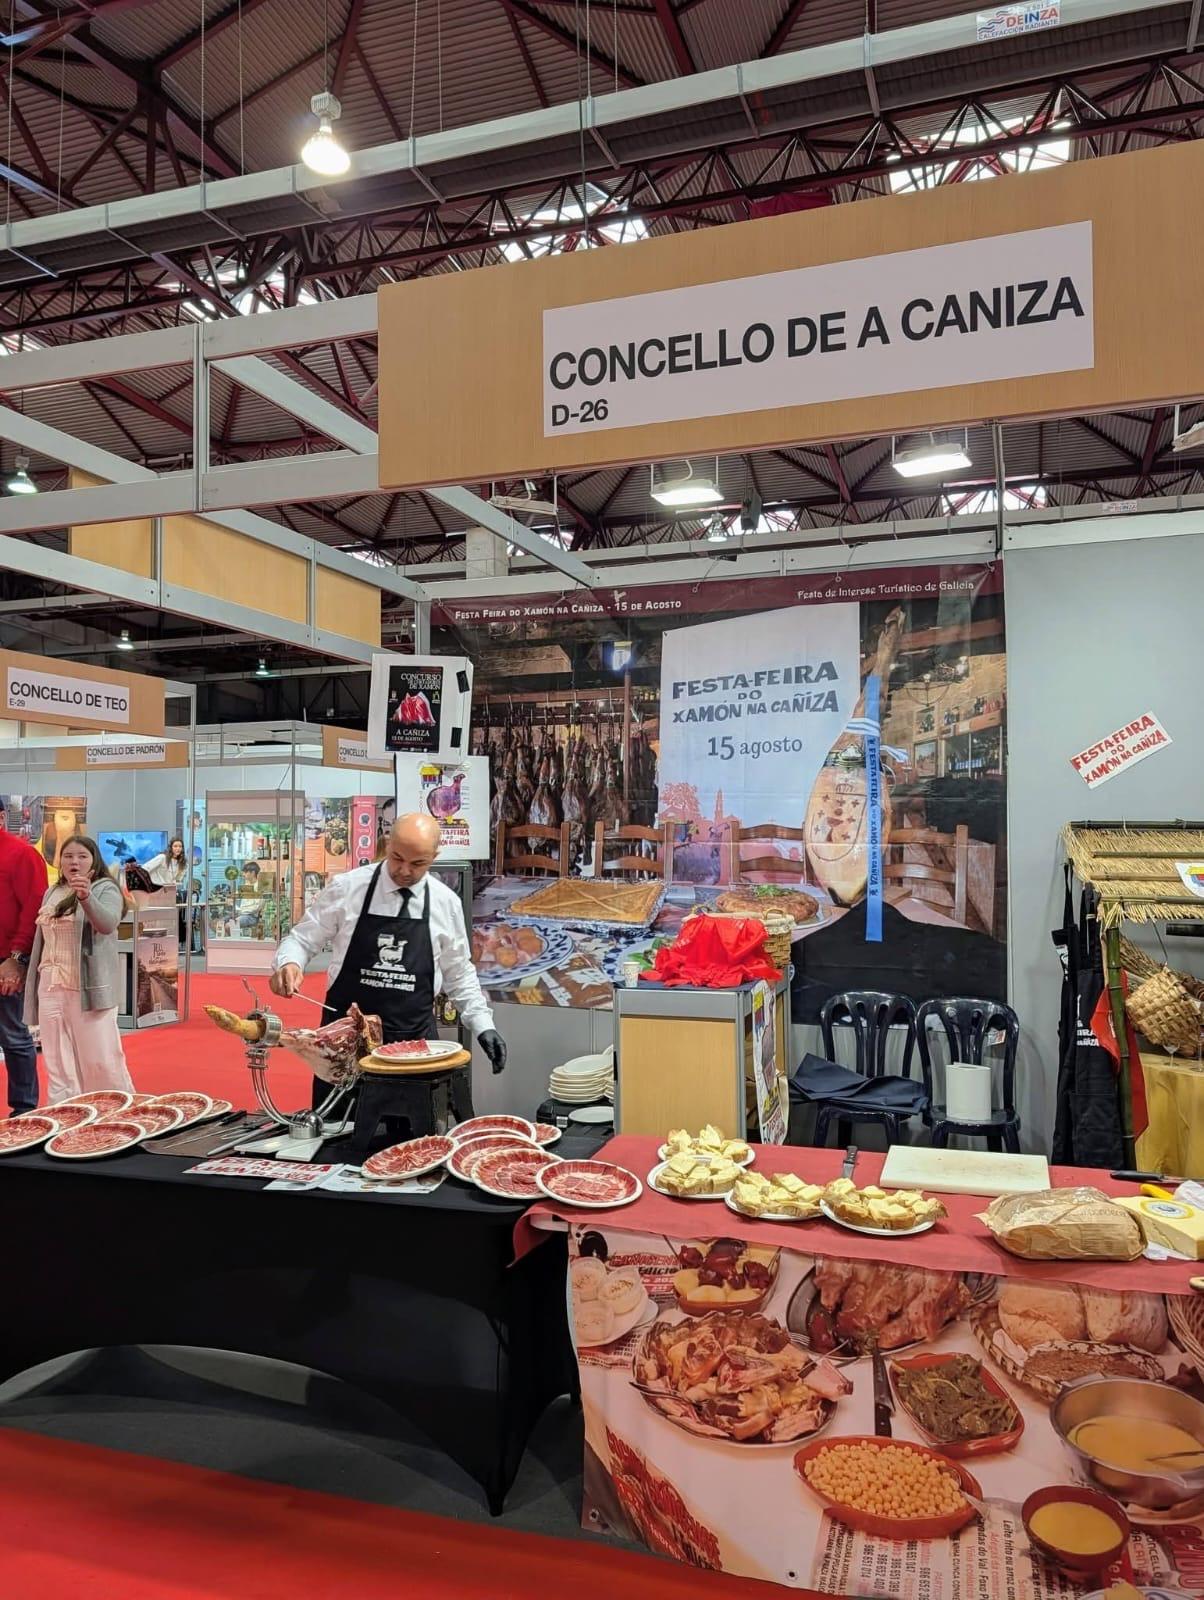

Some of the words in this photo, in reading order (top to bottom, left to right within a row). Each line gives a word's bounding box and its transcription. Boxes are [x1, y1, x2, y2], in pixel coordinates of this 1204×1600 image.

[1006, 7, 1058, 28] DEINZA
[1024, 19, 1057, 30] RADIANTE
[549, 321, 775, 390] CONCELLO
[787, 310, 847, 358] DE
[857, 306, 890, 348] A
[900, 276, 1085, 341] CANIZA
[551, 398, 609, 427] D-26
[825, 588, 836, 598] de
[878, 584, 922, 594] Turístico
[924, 581, 937, 592] de
[939, 580, 974, 591] Galicia
[614, 601, 628, 611] 15
[400, 672, 441, 681] CONCURSO
[672, 660, 840, 700] FESTA-FEIRA
[10, 681, 83, 705] CONCELLO
[86, 693, 102, 708] DE
[104, 696, 127, 712] TEO
[737, 689, 763, 701] DO
[9, 698, 25, 708] E-29
[672, 700, 742, 723] XAMÓN
[747, 702, 768, 716] NA
[707, 736, 735, 760] 15
[739, 737, 803, 760] agosto
[1071, 715, 1155, 770] FESTA-FEIRA
[1110, 744, 1125, 755] DO
[88, 746, 123, 757] CONCELLO
[125, 746, 135, 755] DE
[135, 744, 165, 755] PADRÓN
[1120, 750, 1133, 761] NA
[1003, 1520, 1014, 1539] Leite
[978, 1547, 988, 1557] do
[979, 1558, 989, 1569] Val
